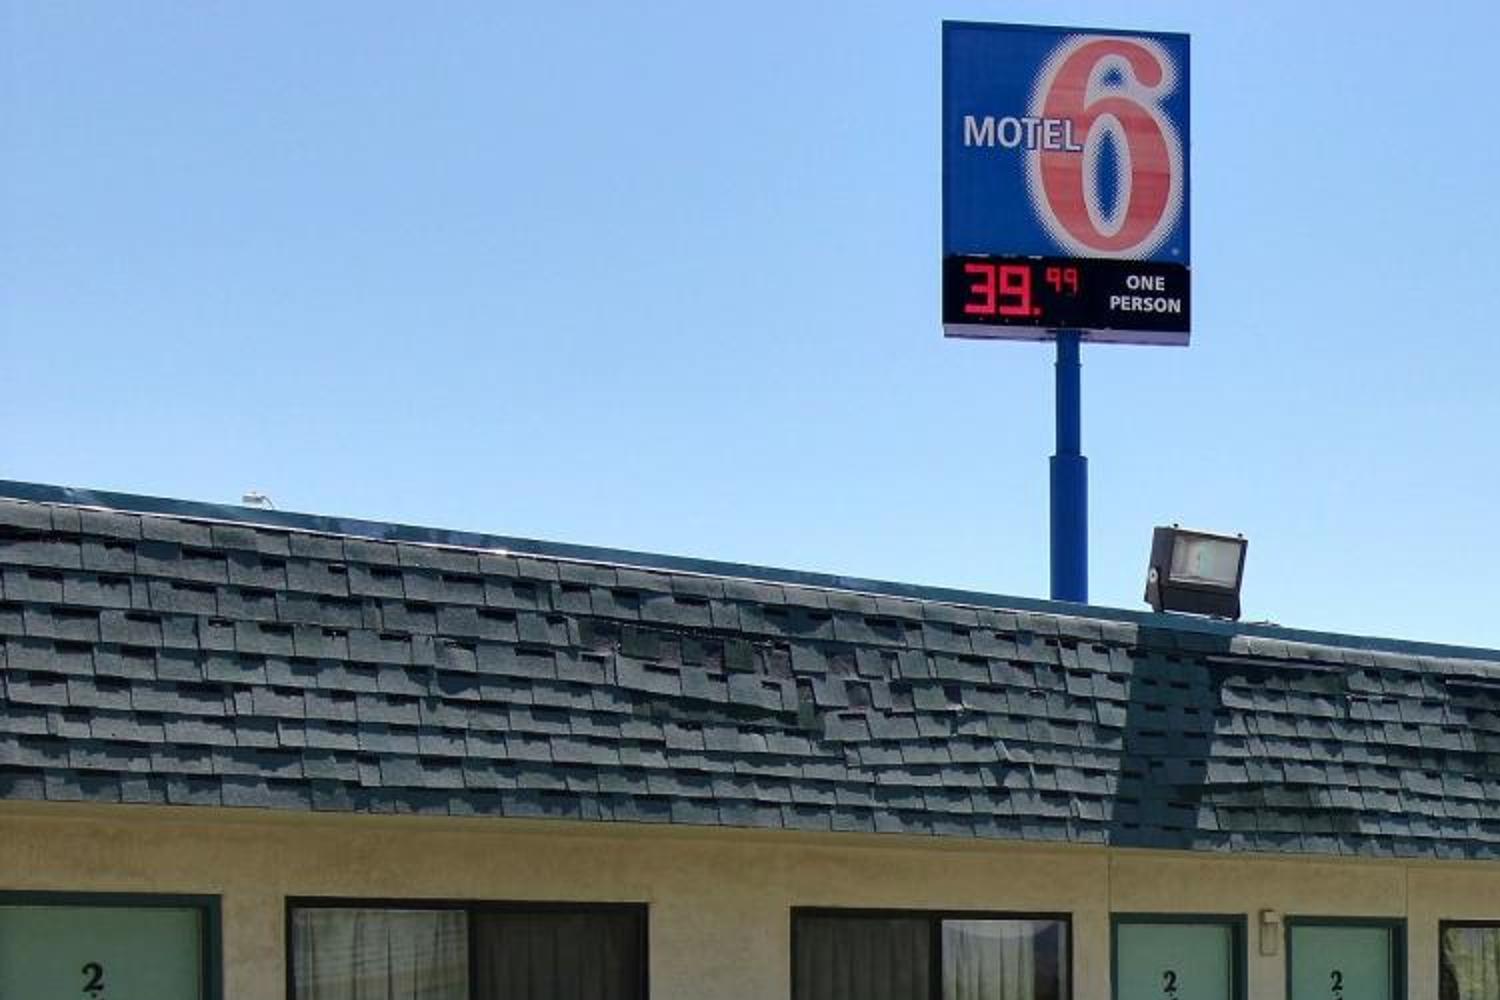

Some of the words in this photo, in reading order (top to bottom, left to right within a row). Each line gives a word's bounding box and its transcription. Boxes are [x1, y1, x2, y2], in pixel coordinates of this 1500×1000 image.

[962, 114, 1083, 152] MOTEL
[1032, 35, 1178, 257] 6
[1126, 274, 1165, 292] ONE
[1109, 295, 1181, 314] PERSON
